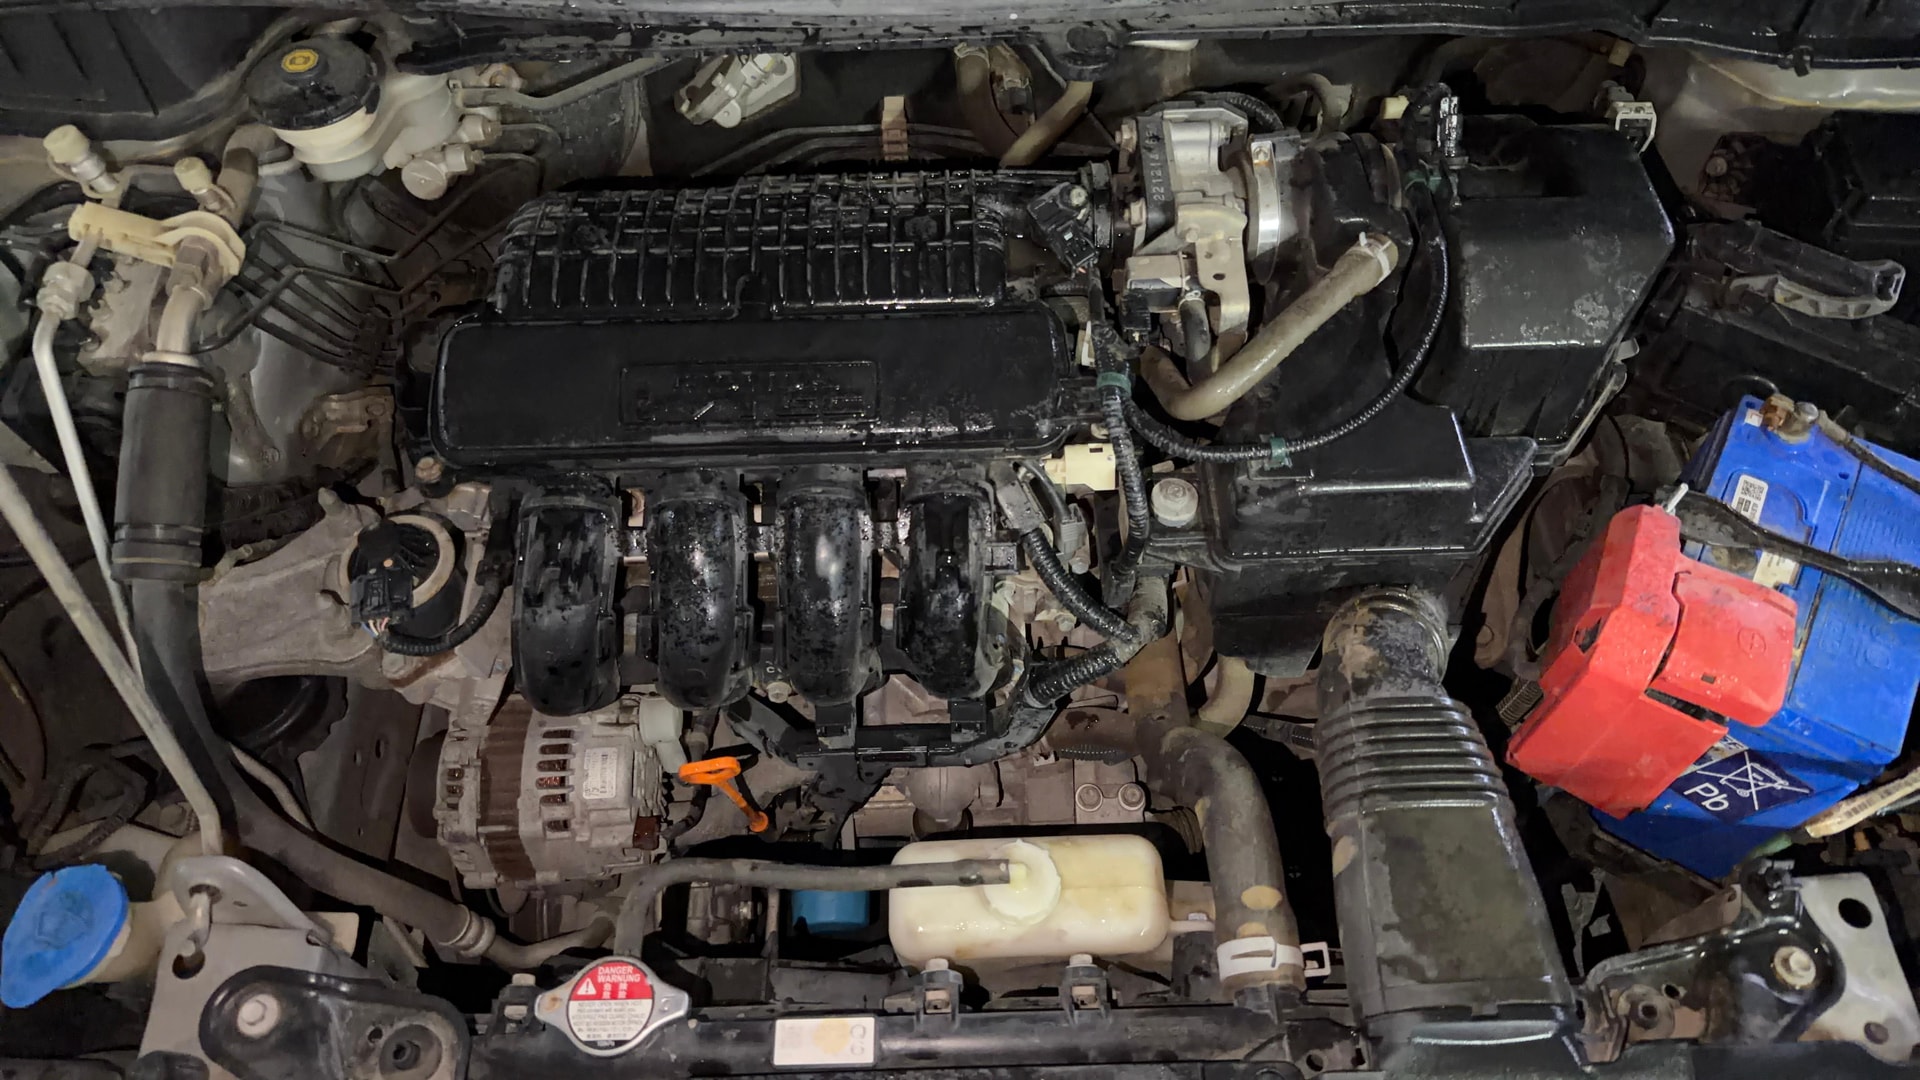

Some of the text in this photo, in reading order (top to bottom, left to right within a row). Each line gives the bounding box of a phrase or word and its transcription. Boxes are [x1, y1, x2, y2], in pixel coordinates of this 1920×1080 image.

[1683, 782, 1729, 811] Pb
[598, 966, 634, 974] DANGER
[597, 974, 641, 983] WARNUNG
